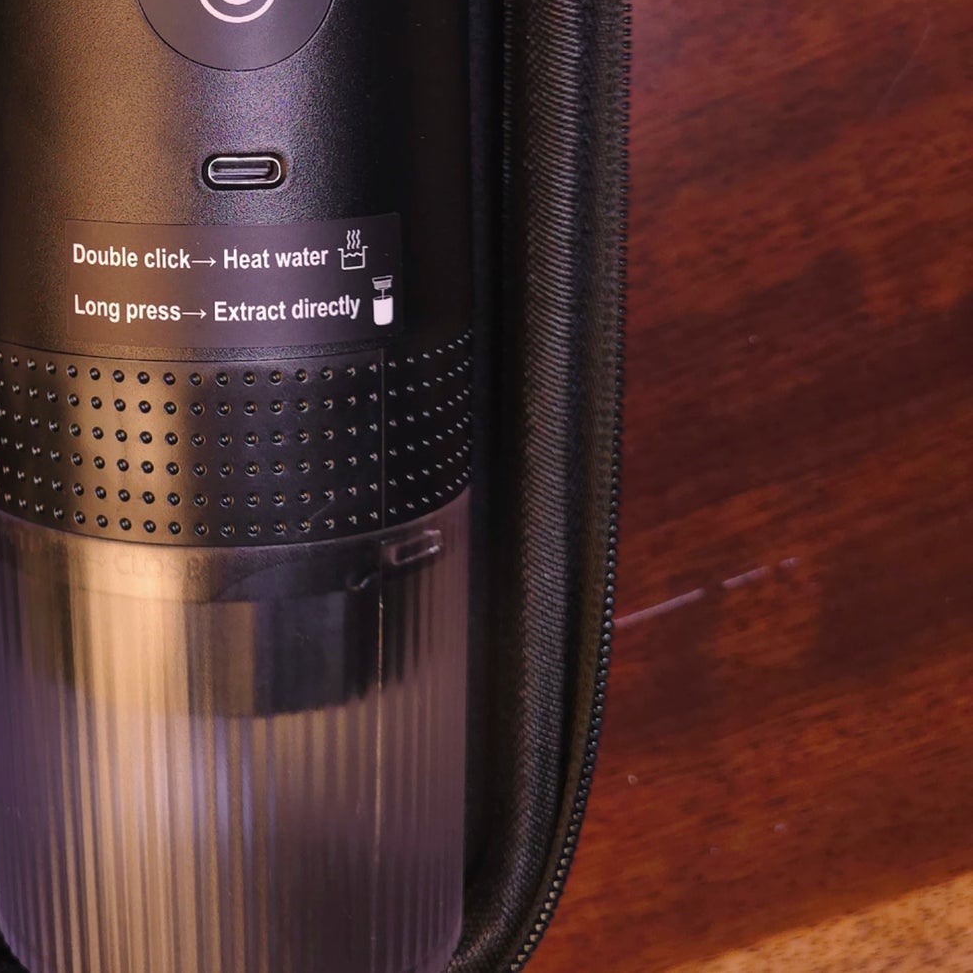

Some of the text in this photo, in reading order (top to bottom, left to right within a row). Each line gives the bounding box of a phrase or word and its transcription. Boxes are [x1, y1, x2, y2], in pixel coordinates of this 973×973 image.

[72, 243, 329, 269] Double click Heat water
[74, 294, 361, 324] Long press Extract directly
